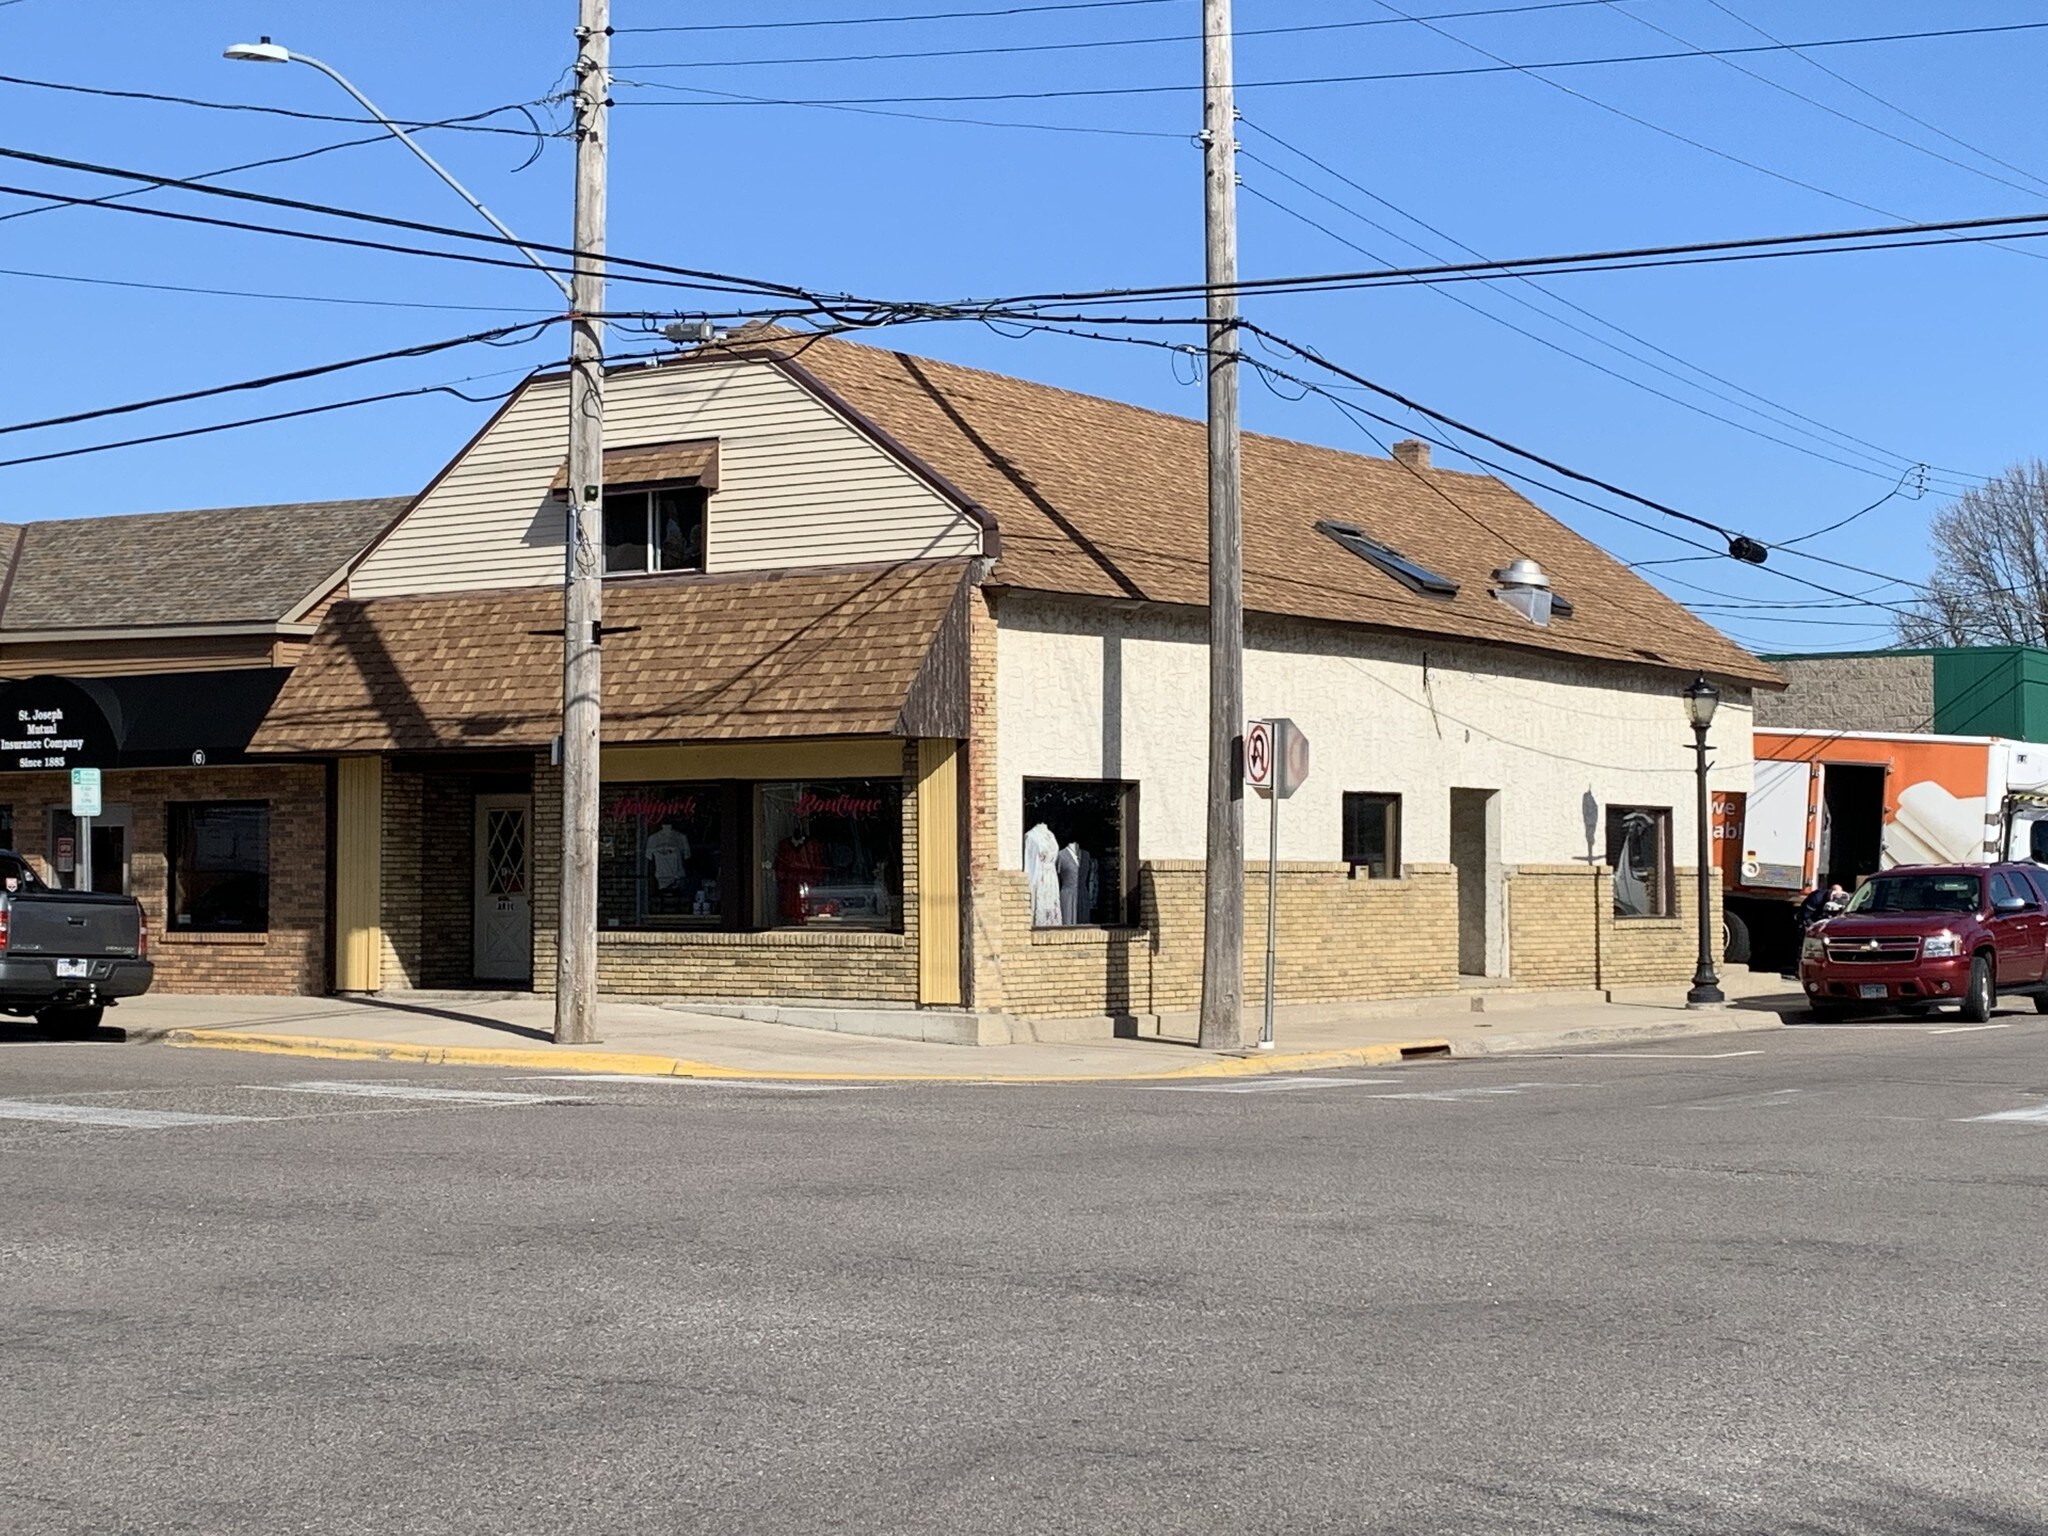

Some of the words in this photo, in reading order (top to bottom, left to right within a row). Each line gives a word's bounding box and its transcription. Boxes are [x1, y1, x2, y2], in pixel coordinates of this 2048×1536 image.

[19, 709, 31, 721] St.
[32, 708, 63, 722] Joseph
[27, 723, 57, 735] Mutual
[1, 739, 42, 750] Insurance
[43, 738, 84, 751] Company
[20, 758, 42, 768] Since
[796, 793, 882, 819] Boutique
